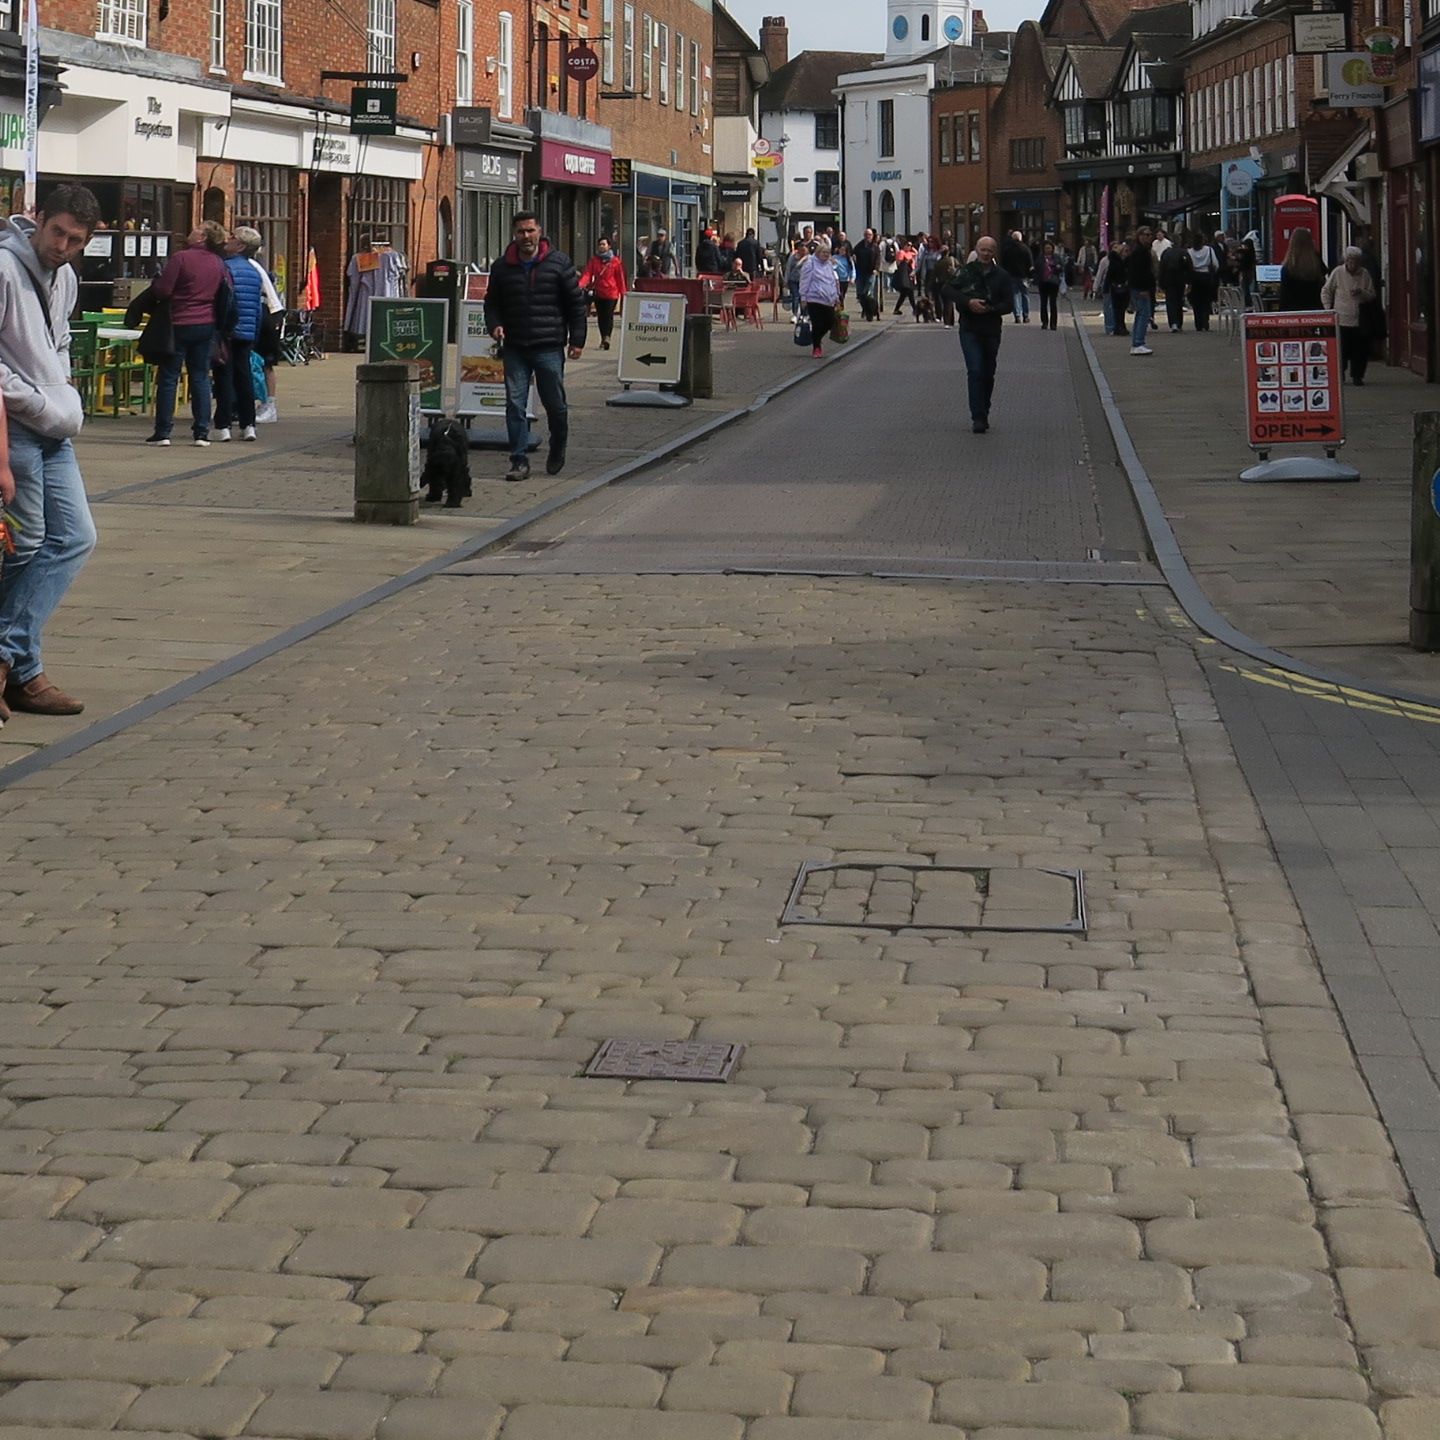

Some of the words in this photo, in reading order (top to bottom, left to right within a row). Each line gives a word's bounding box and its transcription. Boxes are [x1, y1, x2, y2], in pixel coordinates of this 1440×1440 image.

[568, 58, 596, 66] COSTA
[876, 169, 902, 182] BARCLAYS
[628, 322, 678, 334] Emporium
[1254, 423, 1304, 438] OPEN
